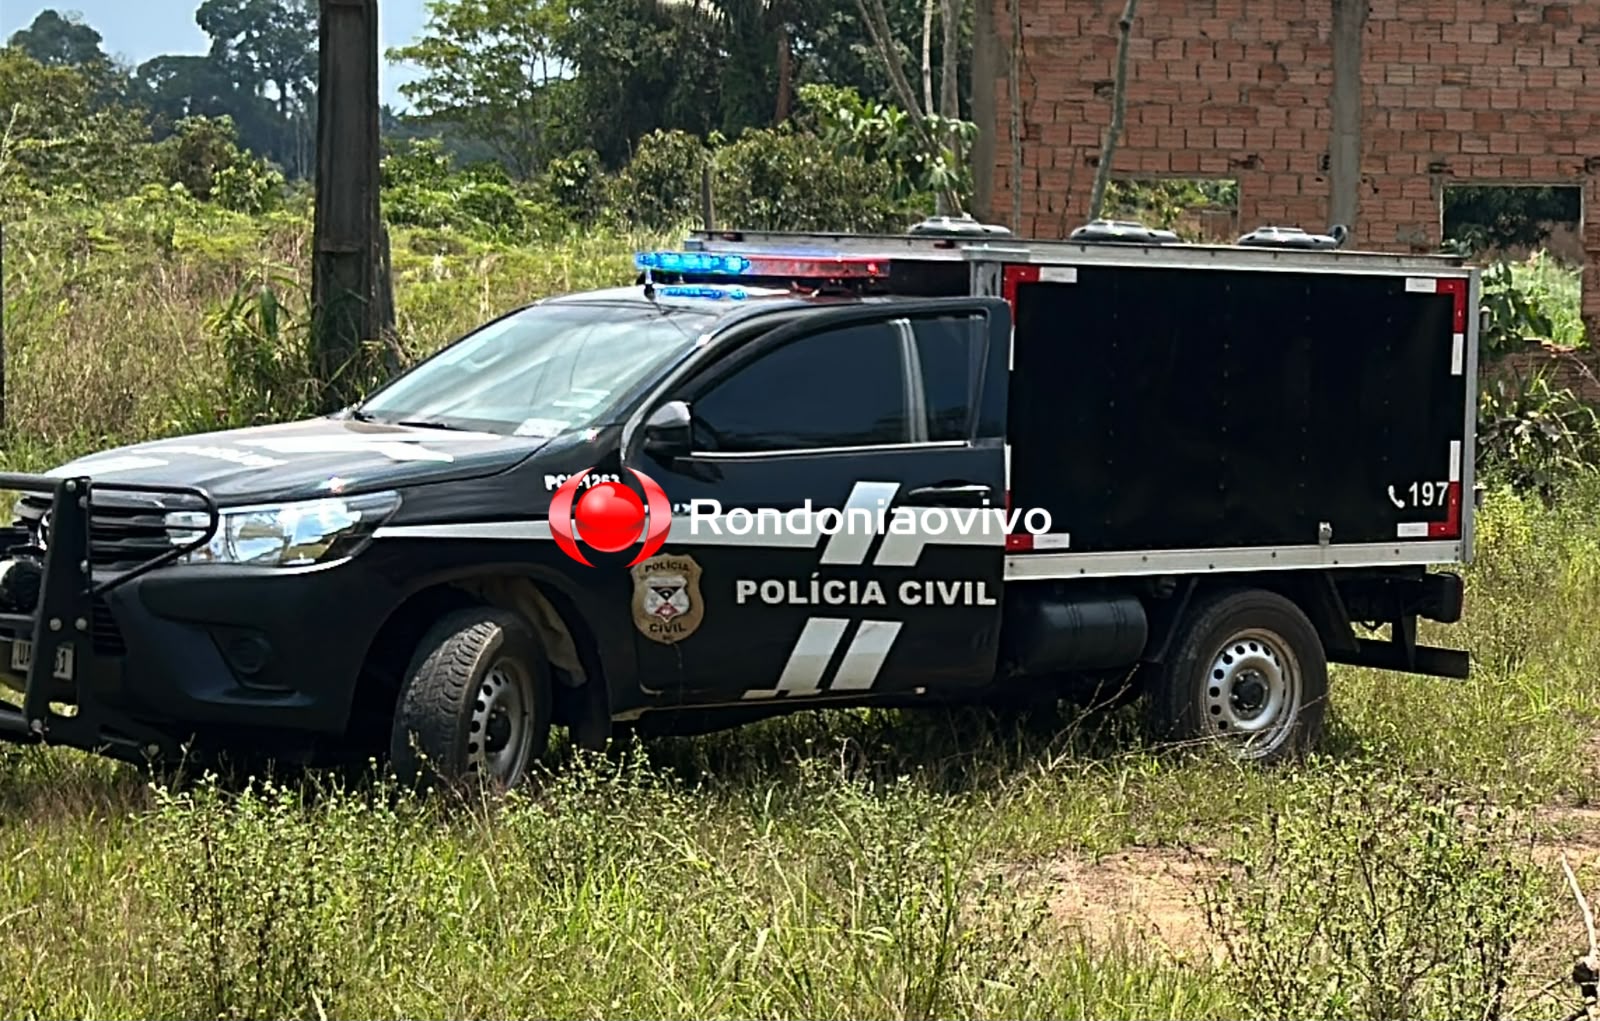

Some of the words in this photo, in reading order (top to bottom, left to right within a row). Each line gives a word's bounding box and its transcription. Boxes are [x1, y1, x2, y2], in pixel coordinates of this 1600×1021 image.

[1408, 481, 1449, 506] 197
[736, 572, 887, 605] POLÍCIA
[899, 581, 996, 606] CIVIL
[649, 622, 686, 633] CIVIL
